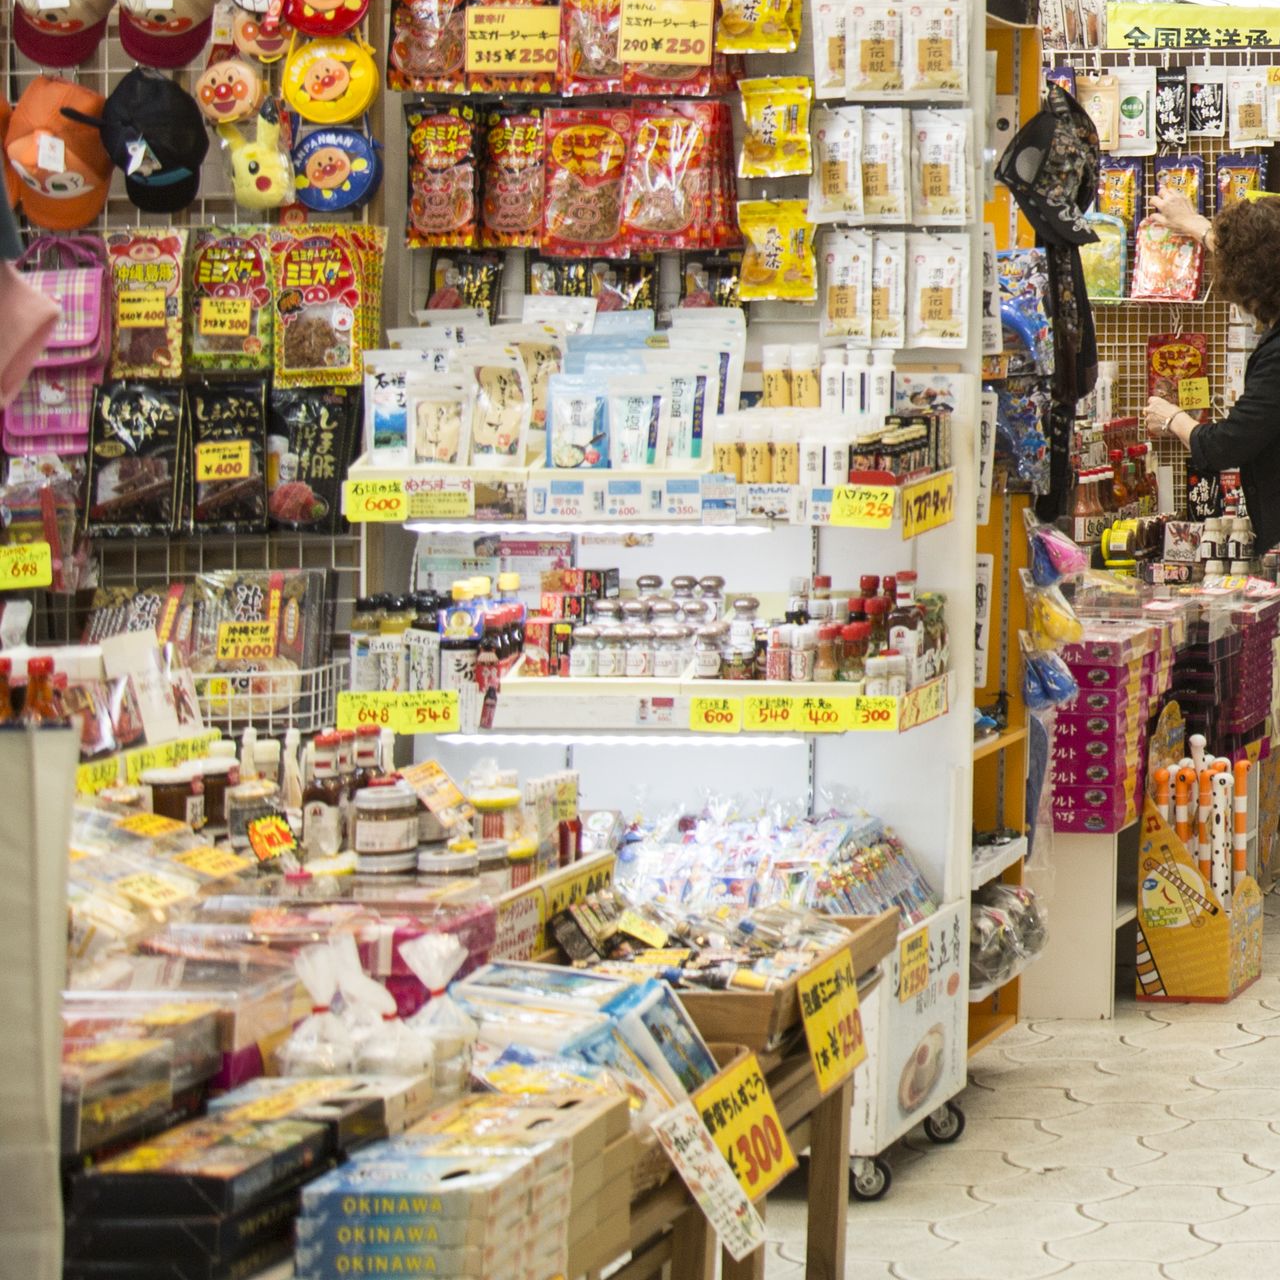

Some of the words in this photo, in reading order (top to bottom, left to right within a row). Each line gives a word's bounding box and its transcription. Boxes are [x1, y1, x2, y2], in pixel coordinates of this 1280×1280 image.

[404, 478, 473, 493] ぬちまーす
[342, 1196, 443, 1215] OKINAWA
[337, 1225, 439, 1245] OKINAWA
[335, 1254, 437, 1274] OKINAWA
